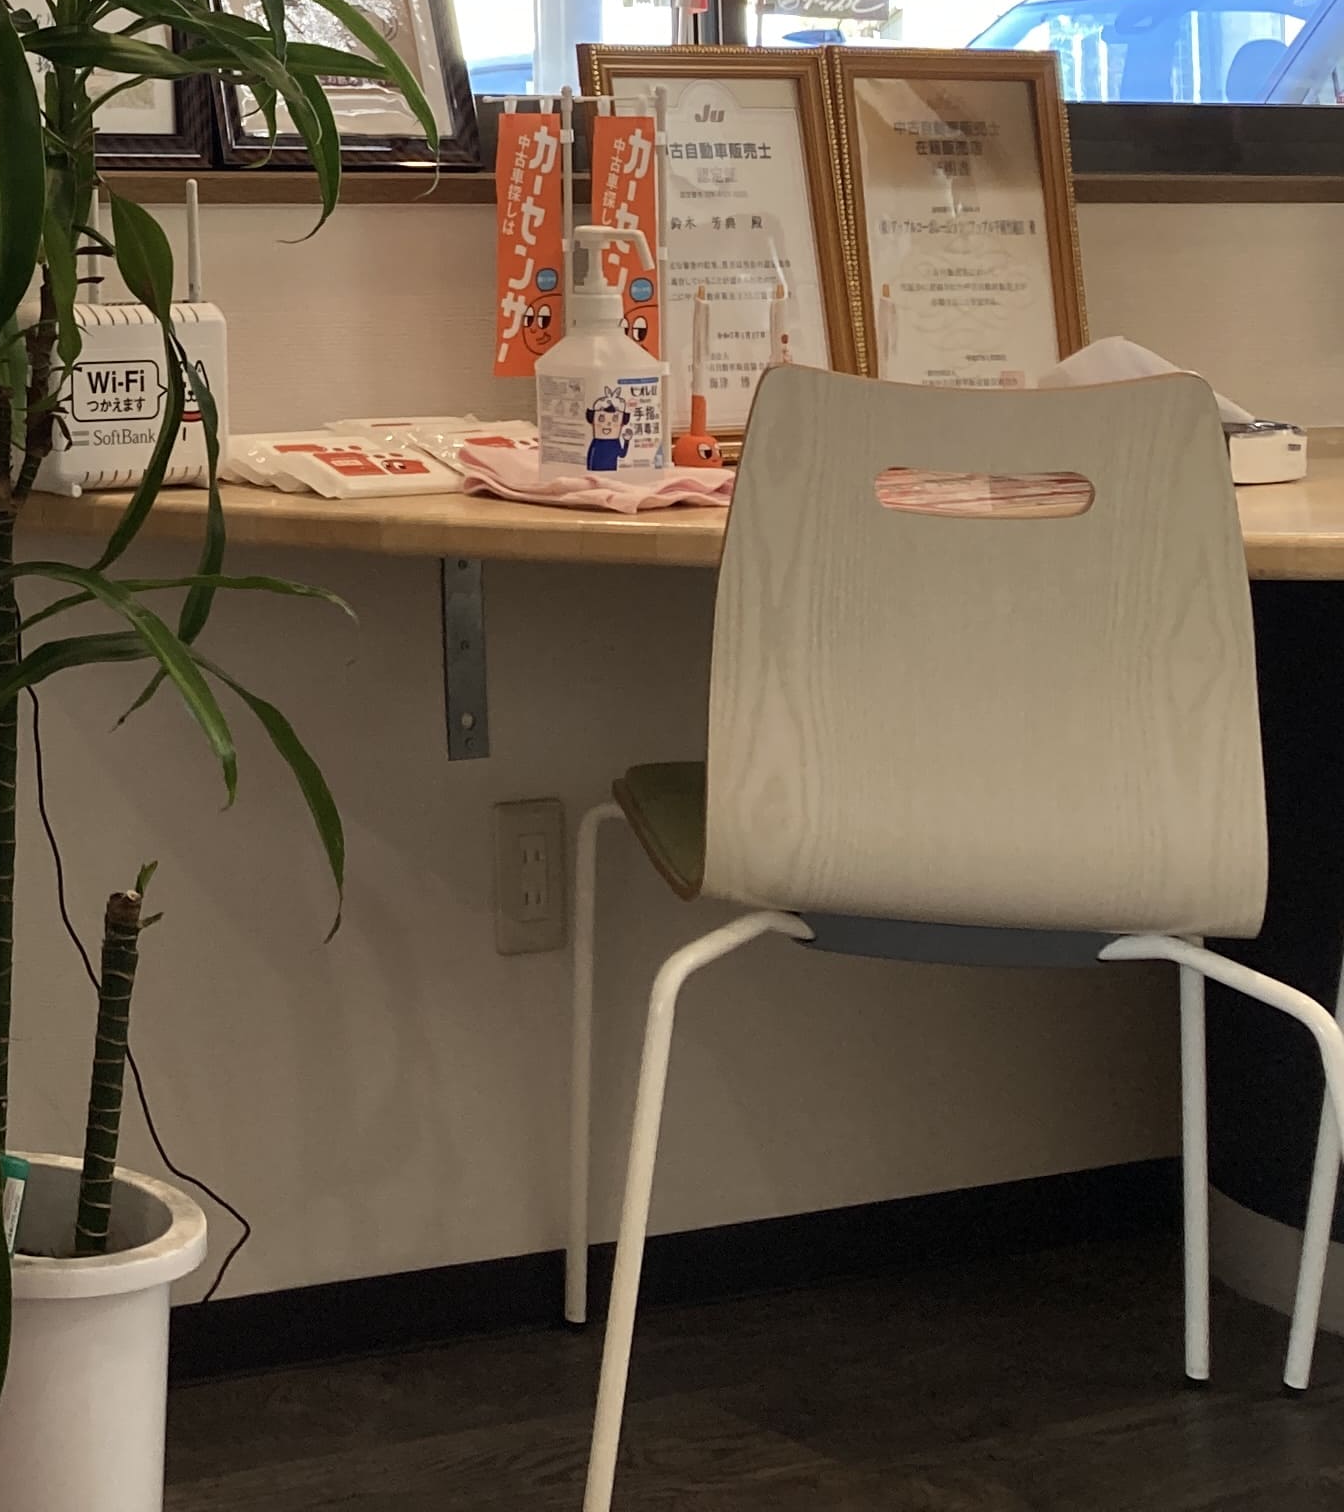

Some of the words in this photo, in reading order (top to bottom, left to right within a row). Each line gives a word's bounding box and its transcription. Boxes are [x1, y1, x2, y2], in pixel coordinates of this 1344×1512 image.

[666, 142, 772, 159] 古自動車販売士
[502, 134, 530, 236] 中古車探しは
[601, 138, 627, 226] 中古車探し
[498, 125, 558, 363] カーセンサー
[87, 371, 145, 394] Wi-Fi
[87, 397, 146, 413] つかえます
[93, 428, 156, 446] SoftBank
